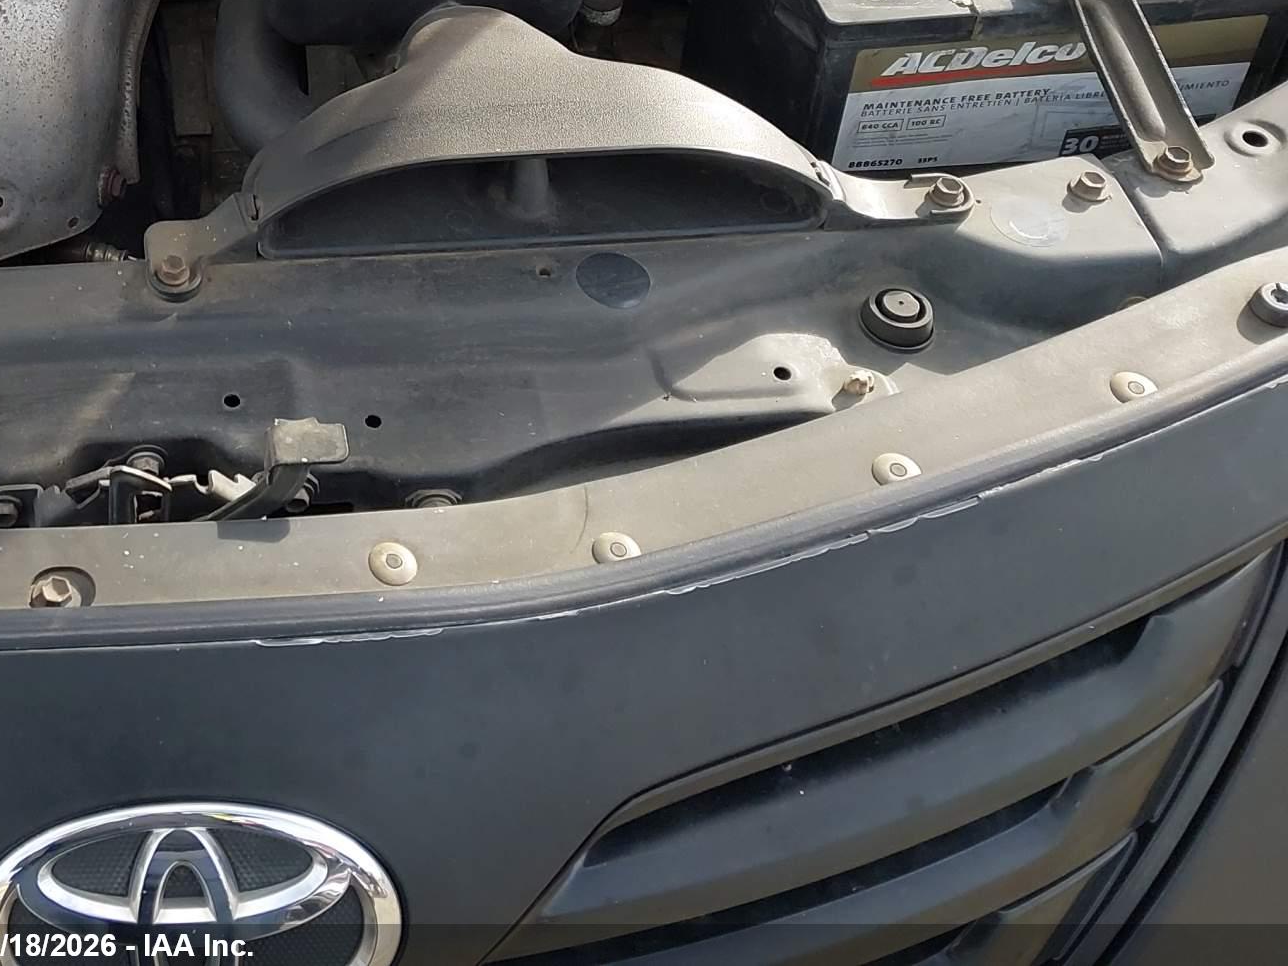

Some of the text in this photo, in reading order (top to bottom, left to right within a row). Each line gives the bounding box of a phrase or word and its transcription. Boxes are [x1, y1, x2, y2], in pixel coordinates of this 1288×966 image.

[880, 41, 1088, 77] ACDelco
[860, 107, 912, 118] BATTERIE
[917, 104, 946, 114] SANS
[950, 99, 1012, 111] ENTRETIEN
[1023, 94, 1071, 104] BATERIA
[863, 88, 1051, 111] MAINTENANCE FREE BATTERY
[1064, 135, 1100, 154] 30
